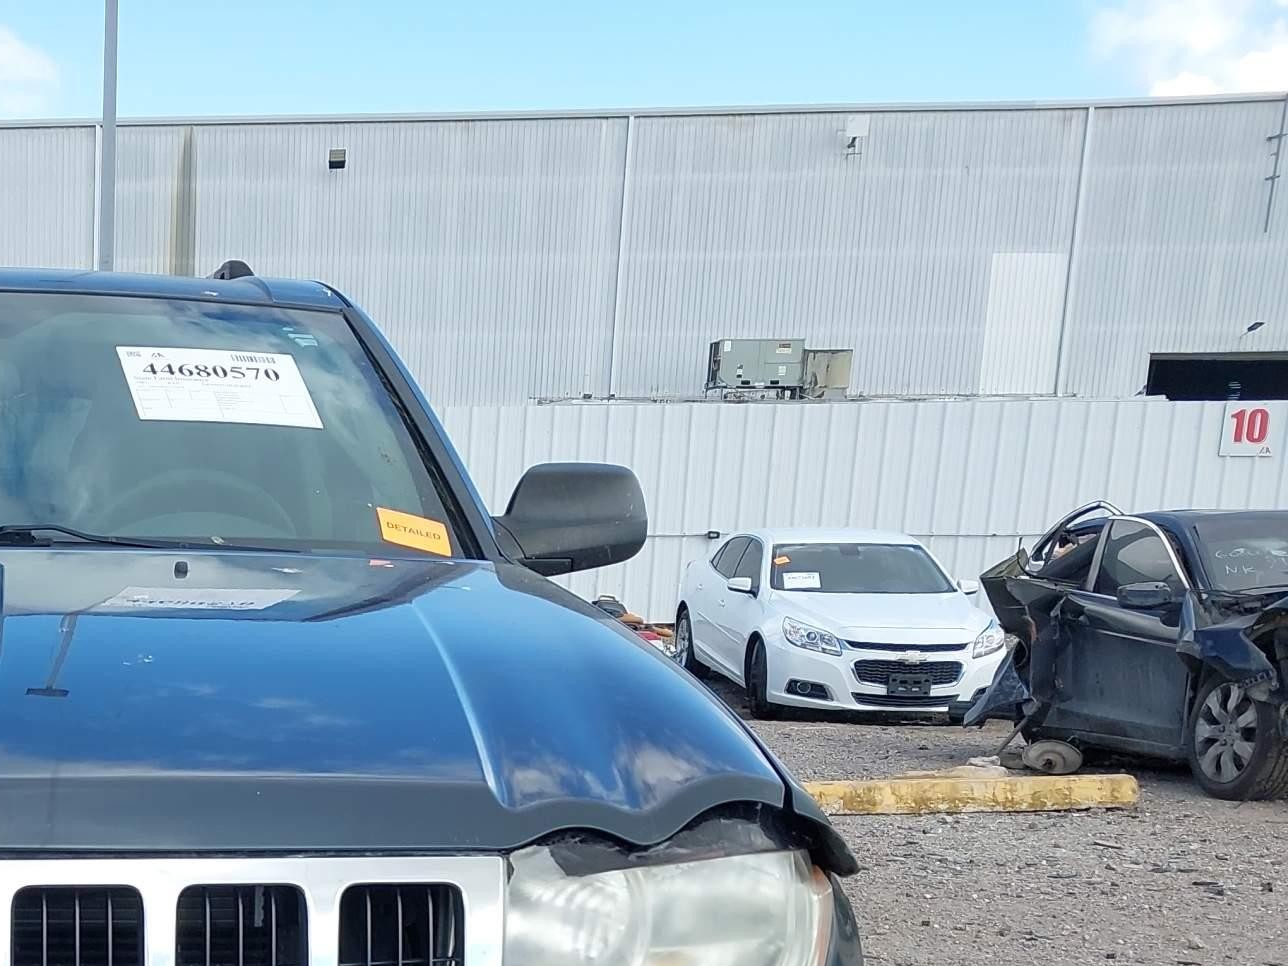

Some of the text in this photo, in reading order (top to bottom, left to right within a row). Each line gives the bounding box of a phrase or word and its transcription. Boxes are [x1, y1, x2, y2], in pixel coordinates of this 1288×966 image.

[142, 362, 280, 382] 44680570
[1231, 408, 1269, 443] 10
[386, 521, 441, 540] DETAILED
